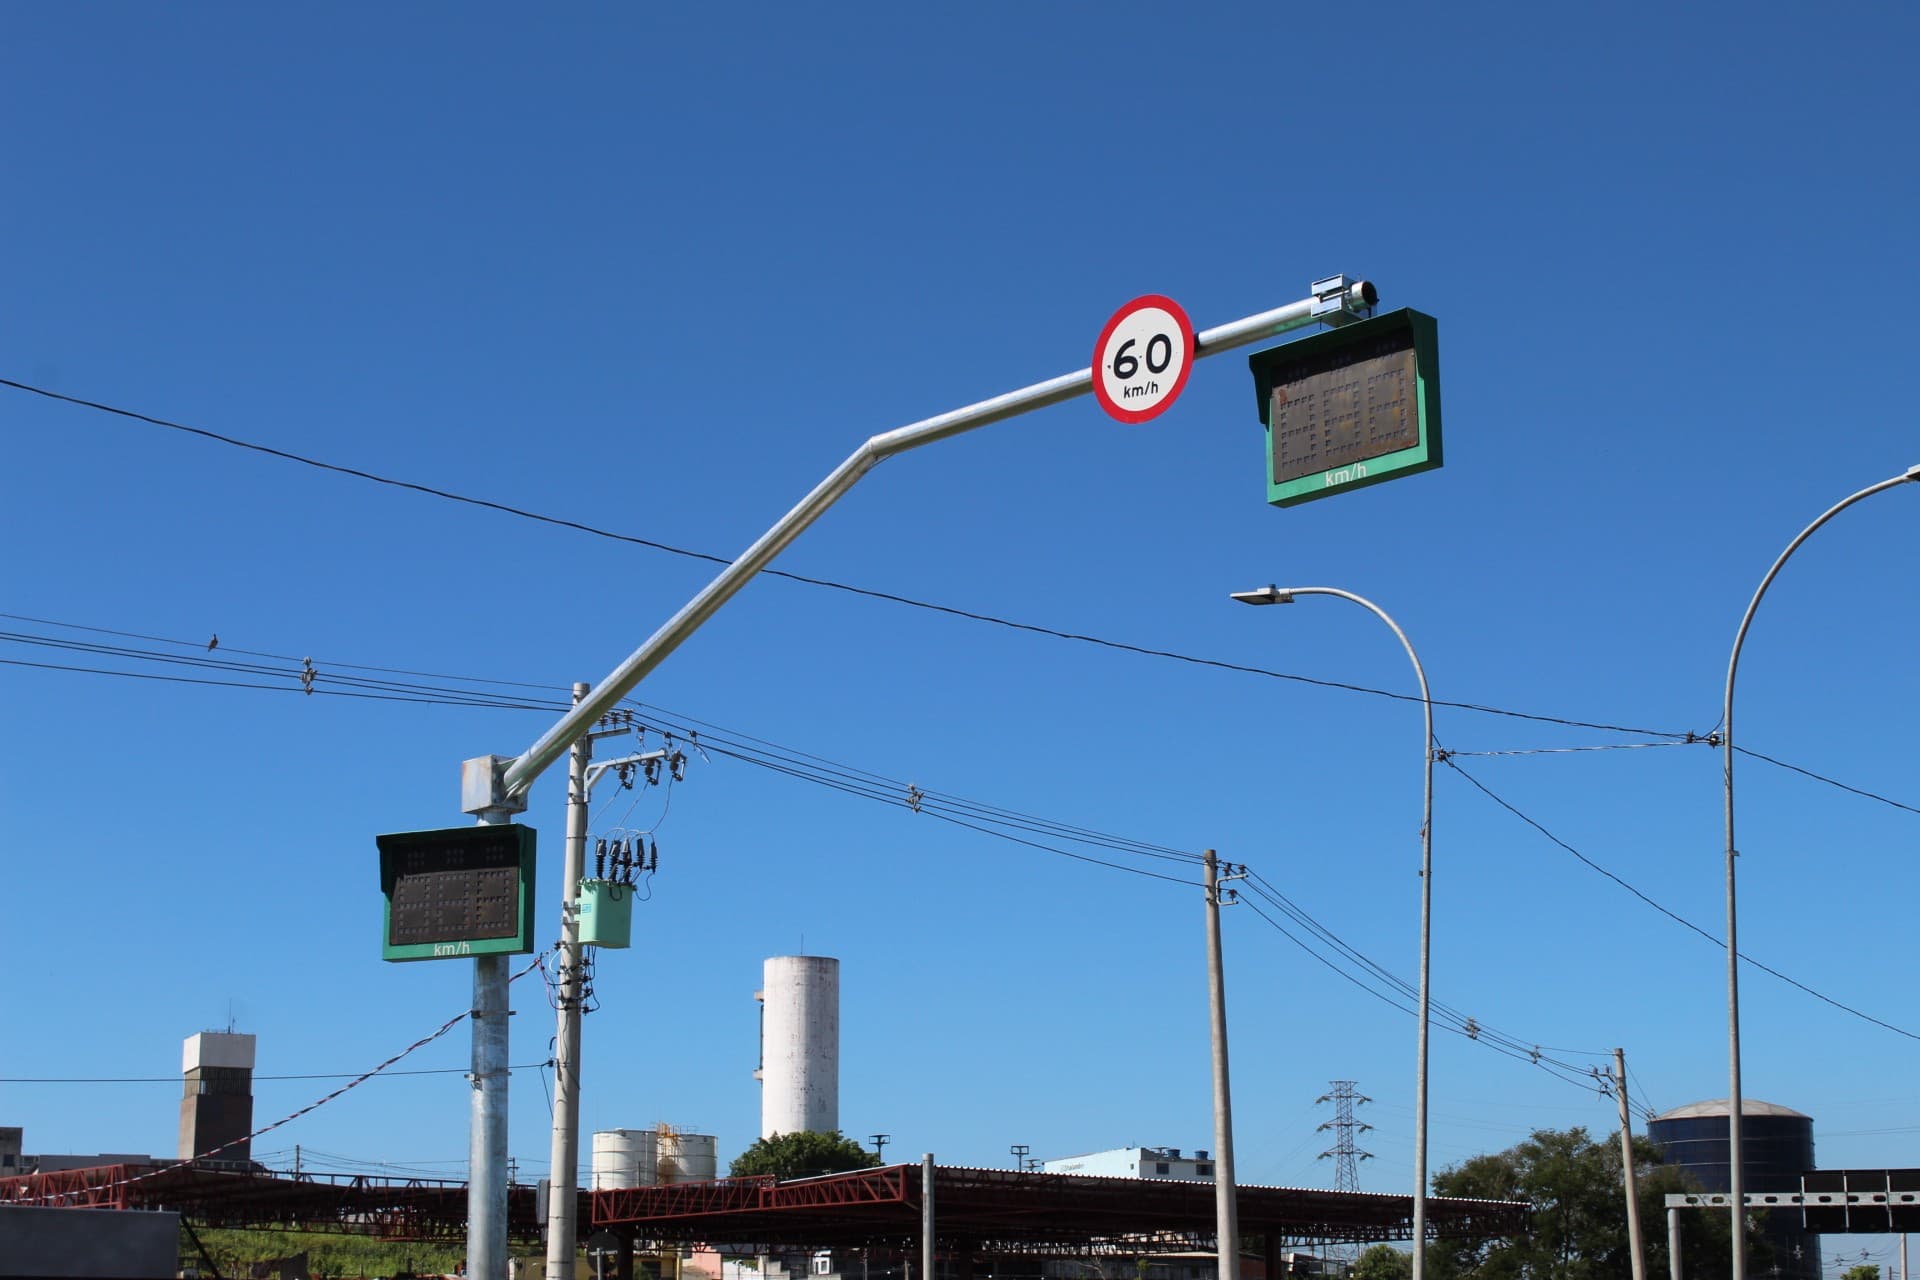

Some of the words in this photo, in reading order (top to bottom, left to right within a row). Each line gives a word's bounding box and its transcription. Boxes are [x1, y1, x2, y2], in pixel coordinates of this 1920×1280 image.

[1114, 334, 1171, 379] 60
[1124, 382, 1158, 398] km/h
[1327, 463, 1366, 486] km/h
[434, 941, 470, 956] km/h
